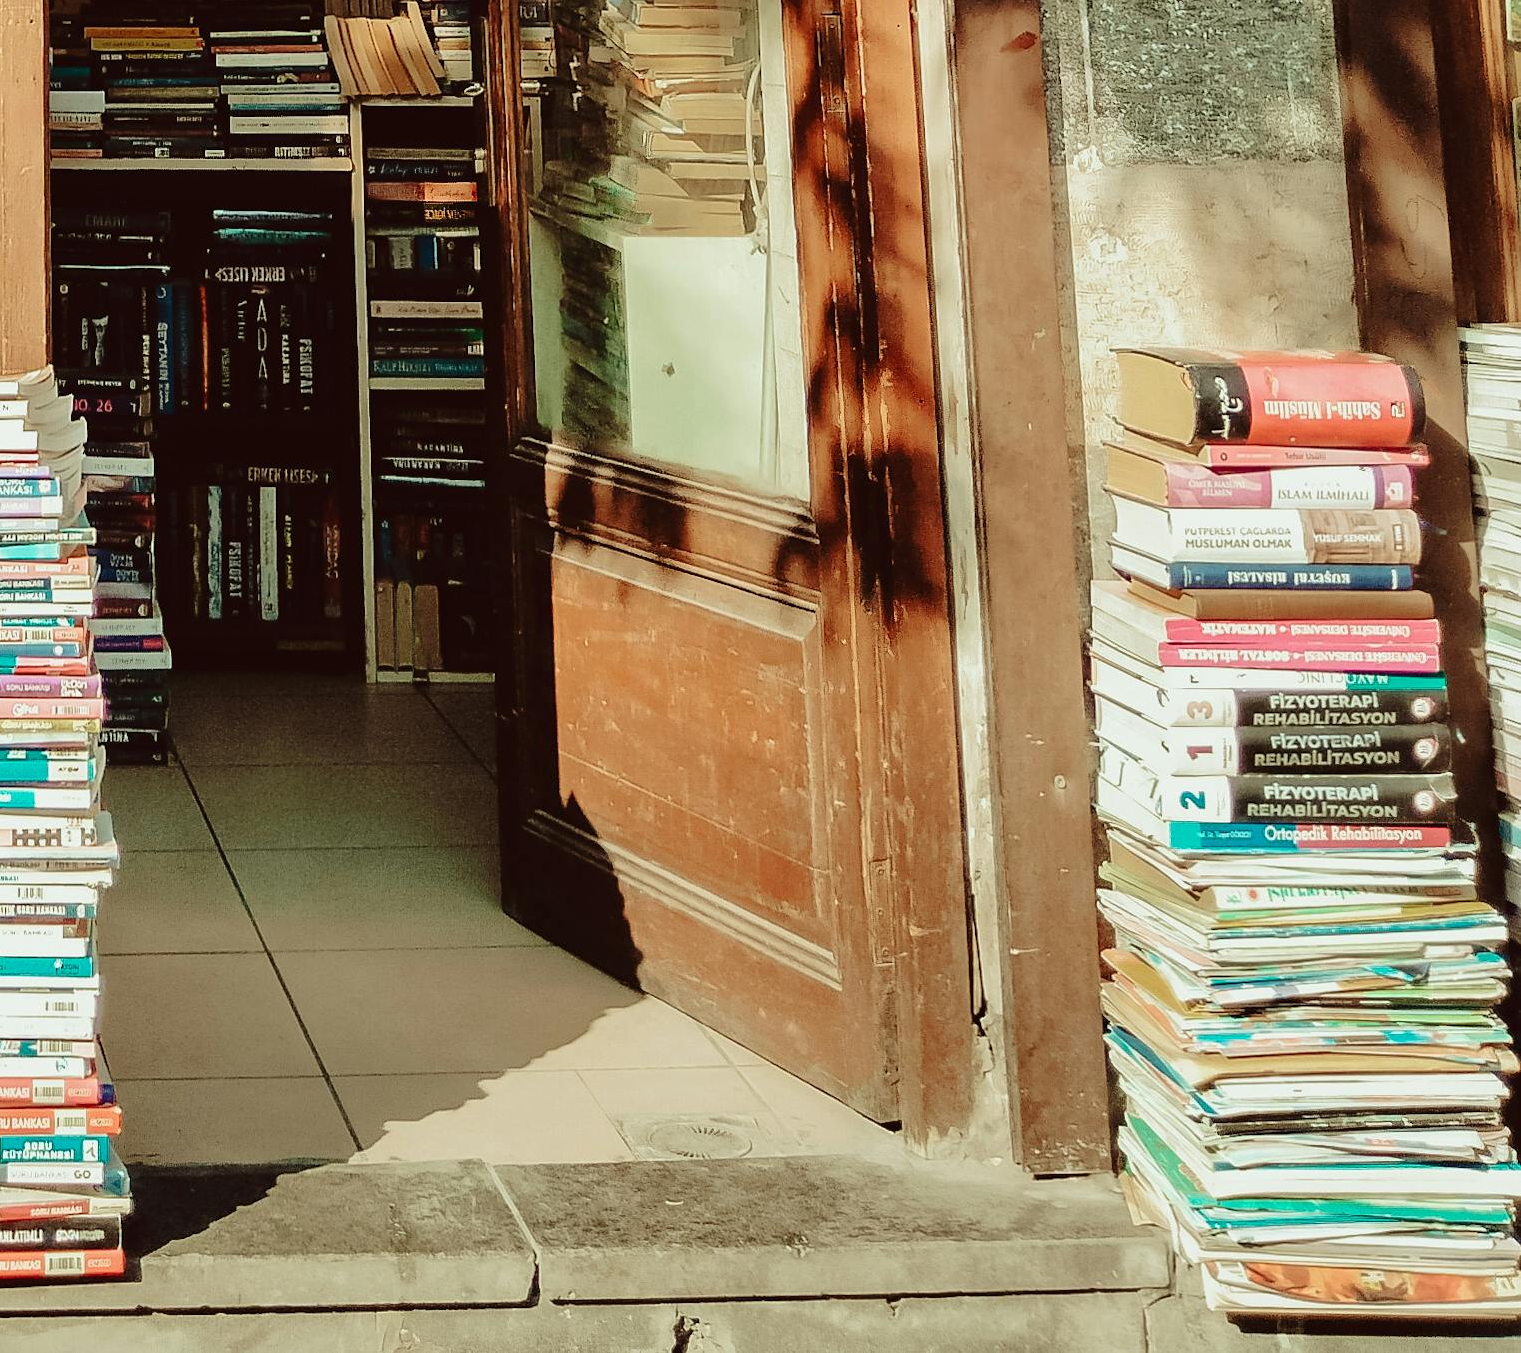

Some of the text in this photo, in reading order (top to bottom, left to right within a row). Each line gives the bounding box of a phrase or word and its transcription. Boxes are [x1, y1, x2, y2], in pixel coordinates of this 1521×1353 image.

[1264, 400, 1322, 420] Müslim
[1253, 538, 1292, 549] OLMAK
[1187, 700, 1213, 721] 3
[1269, 694, 1378, 710] FİZYOTERAPİ
[1253, 710, 1397, 727] REHABİLİTASYON
[1270, 732, 1381, 749] FİZYOTERAPİ
[1254, 750, 1401, 767] REHABİLİTASYON
[1264, 782, 1379, 801] FİZYOTERAPİ
[1181, 791, 1206, 811] 2
[1247, 801, 1398, 818] REHABİLİTASYON
[1264, 826, 1422, 845] Ortopedik Rehabilitasyon
[11, 1118, 50, 1130] BANKASI
[13, 1260, 41, 1272] BANKASI
